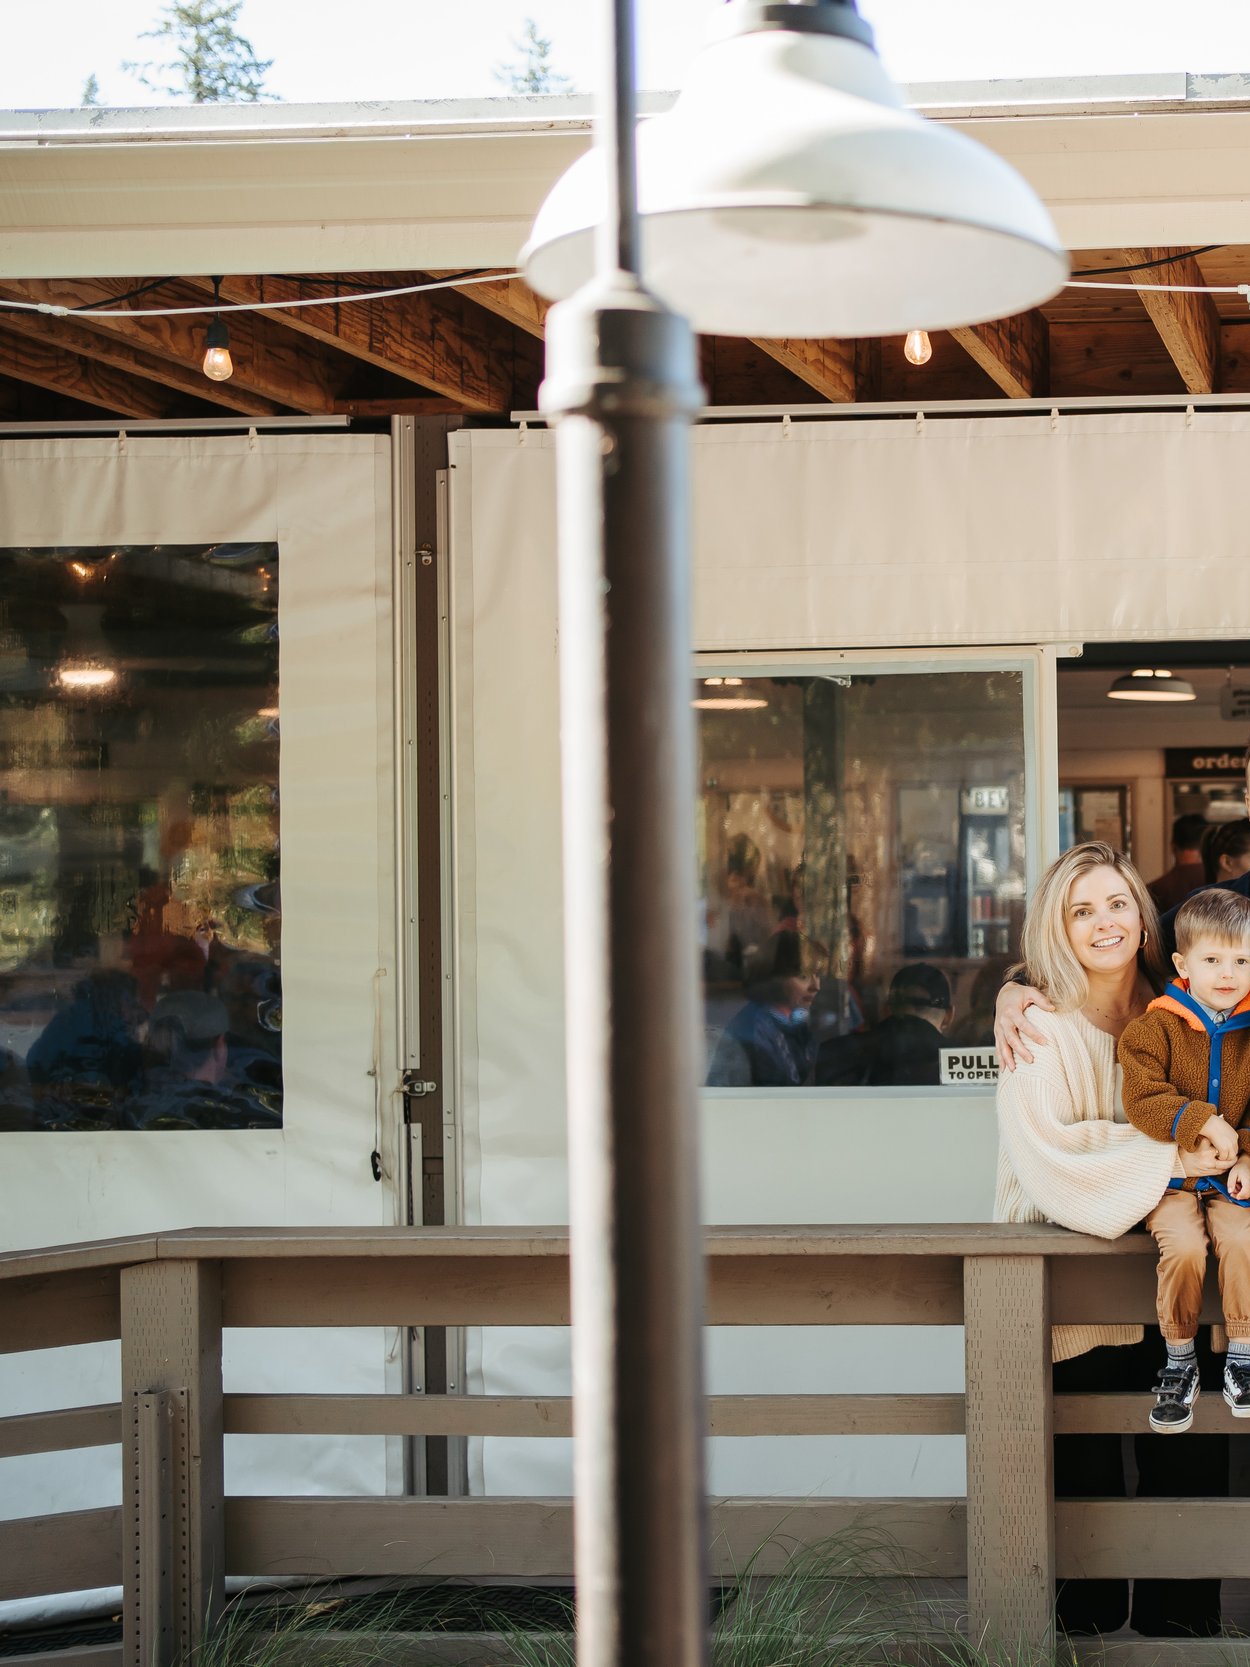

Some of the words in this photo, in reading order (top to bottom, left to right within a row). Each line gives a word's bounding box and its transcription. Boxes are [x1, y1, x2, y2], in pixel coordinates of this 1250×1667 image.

[948, 1055, 1000, 1070] PULL
[948, 1071, 964, 1080] TO
[967, 1070, 999, 1080] OPEN
